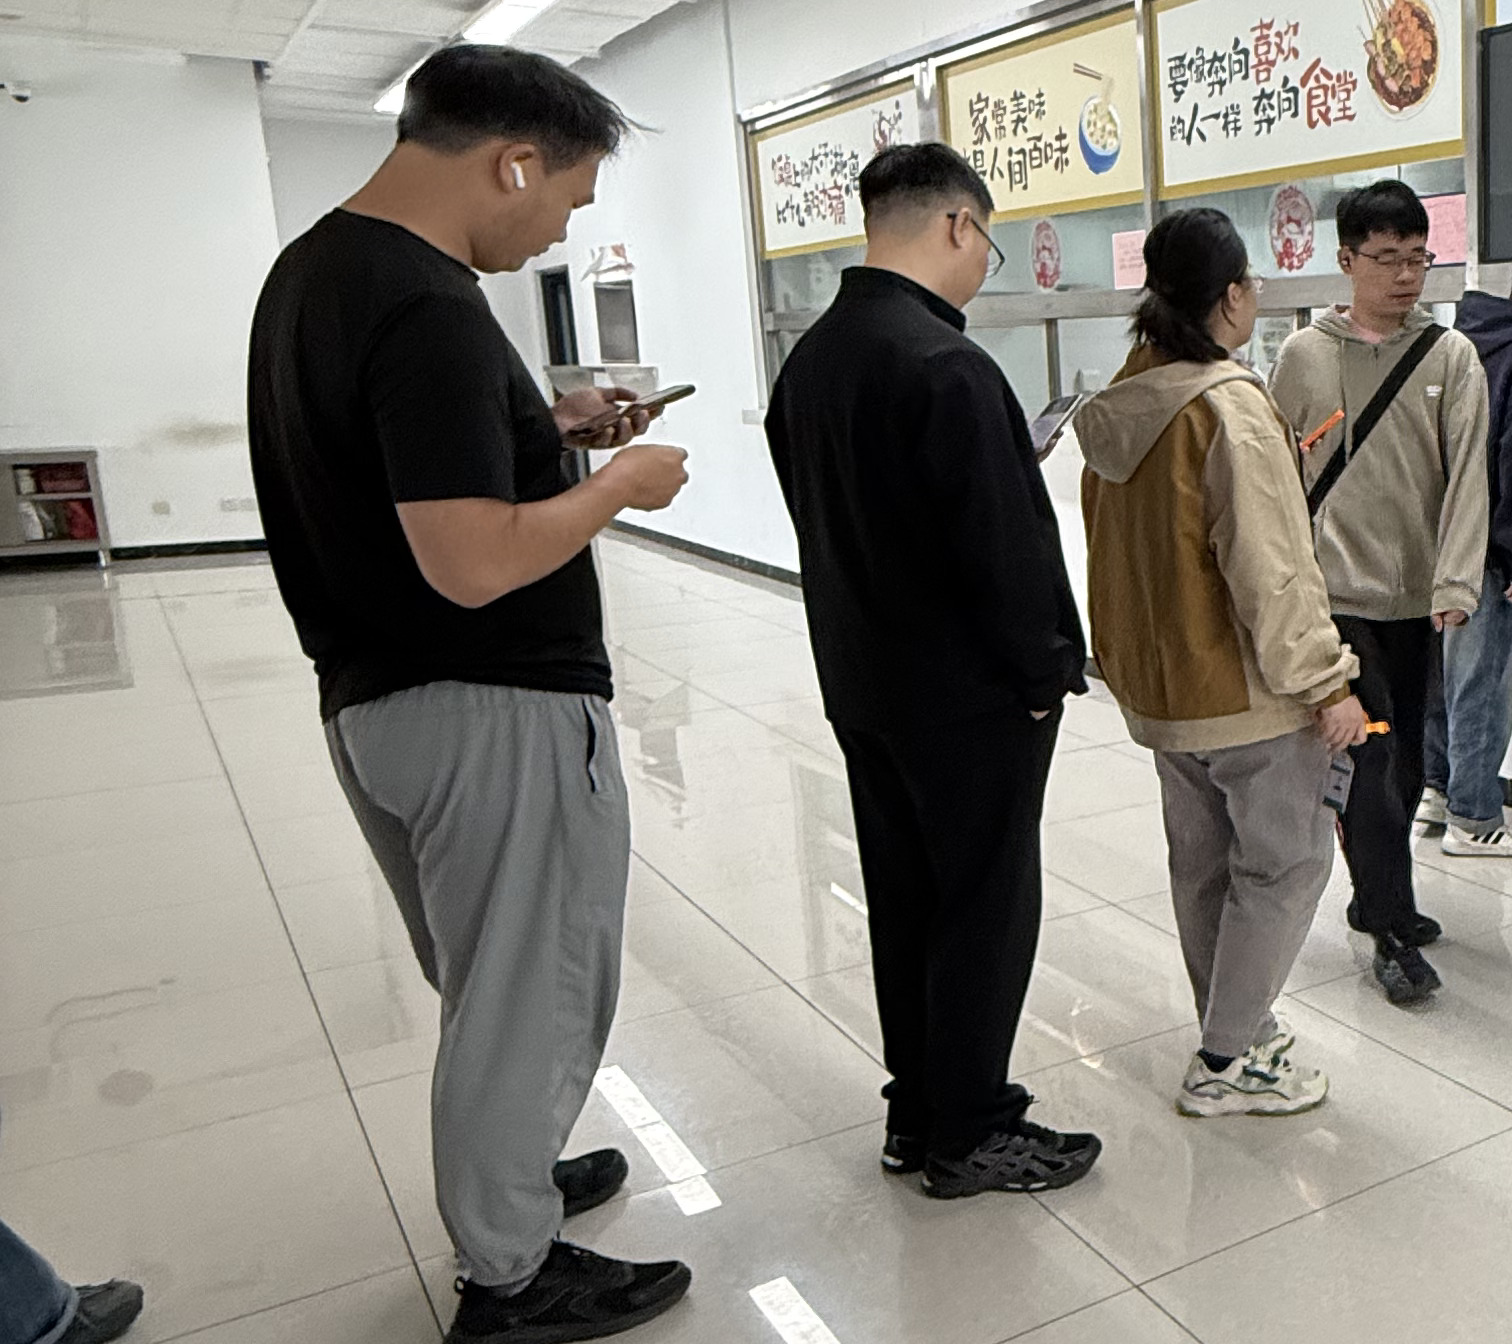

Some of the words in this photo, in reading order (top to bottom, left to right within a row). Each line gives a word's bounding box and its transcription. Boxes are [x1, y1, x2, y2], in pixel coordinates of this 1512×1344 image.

[1167, 17, 1300, 103] 要像奔向喜欢
[968, 87, 1047, 146] 家常美味
